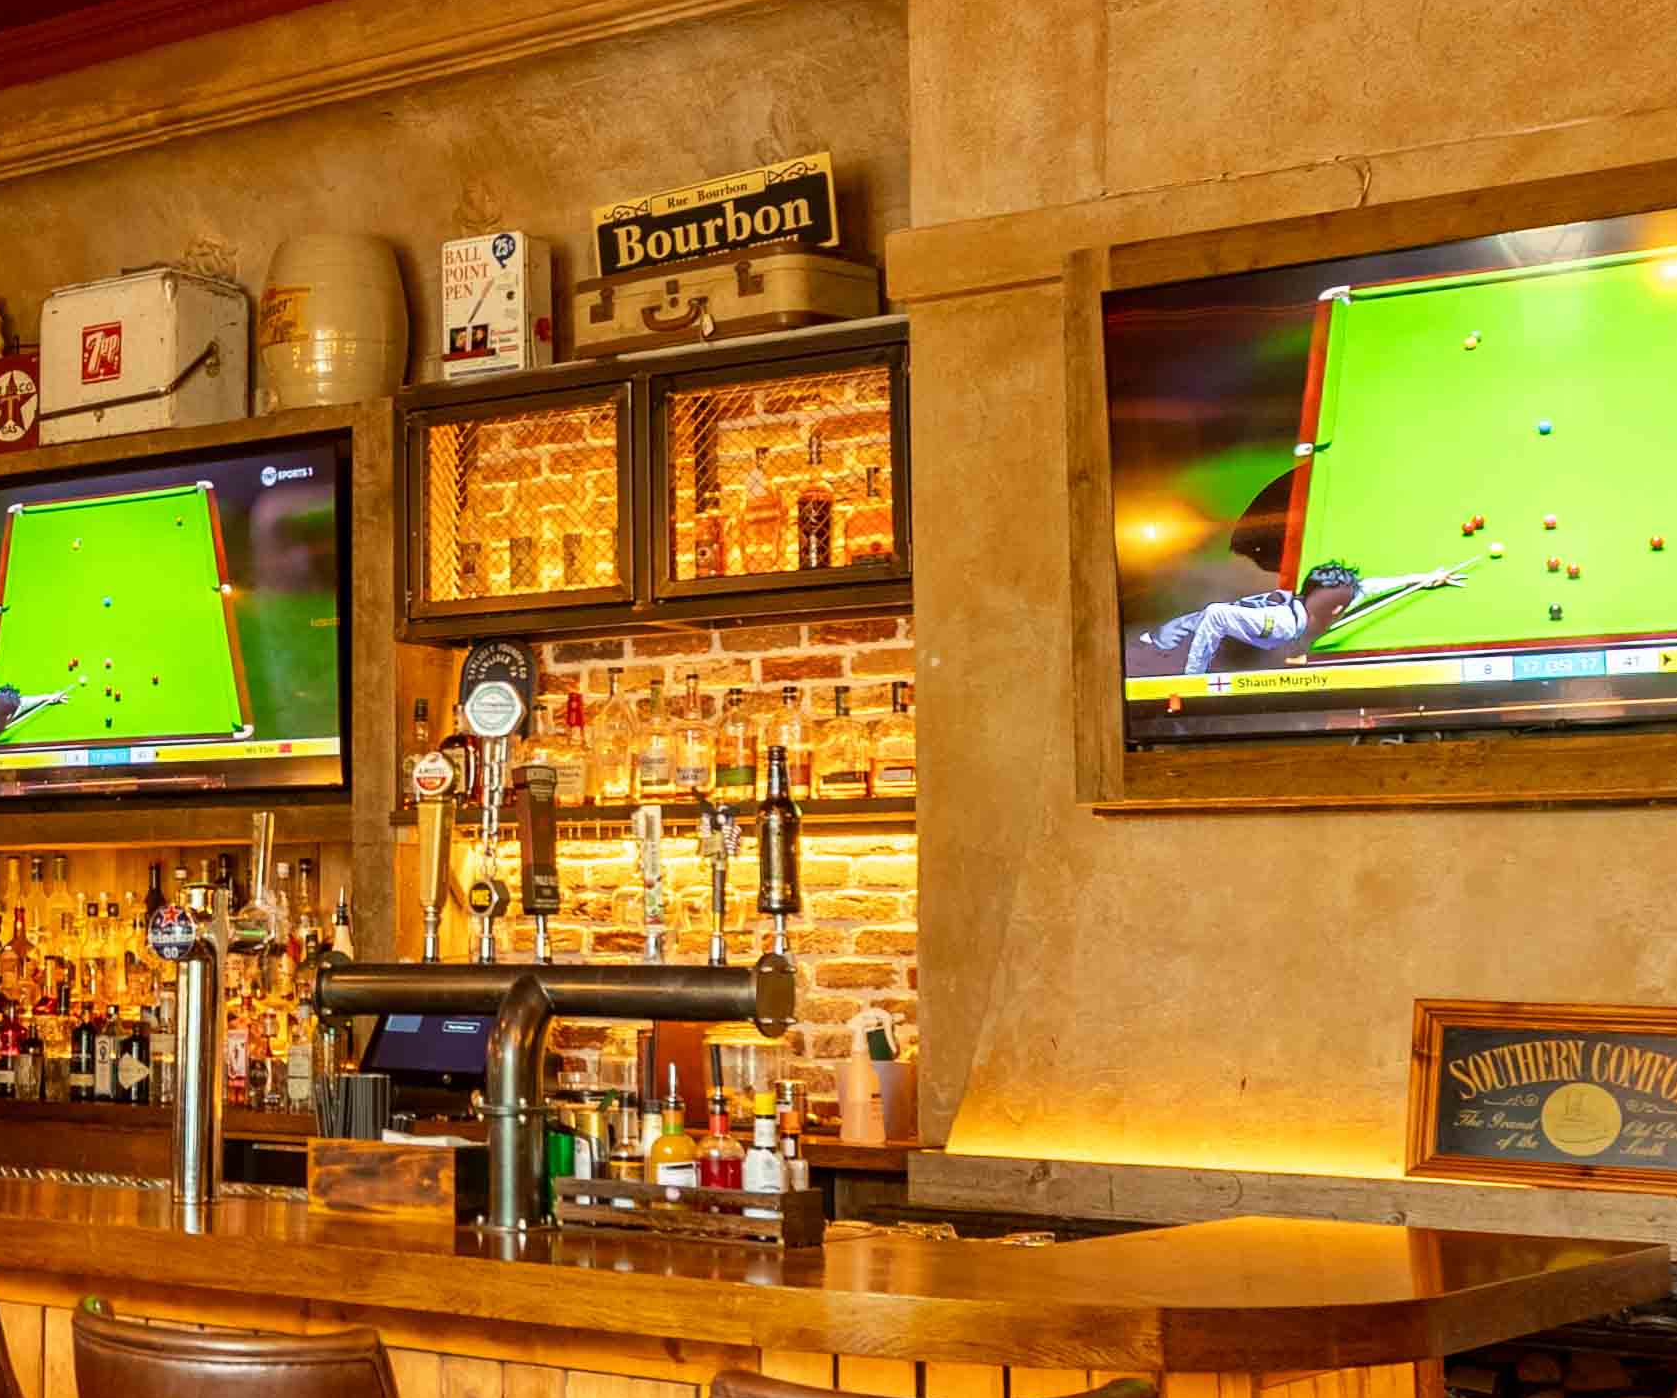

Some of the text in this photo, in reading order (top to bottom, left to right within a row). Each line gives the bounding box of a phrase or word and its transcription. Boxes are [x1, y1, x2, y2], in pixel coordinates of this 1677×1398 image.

[667, 182, 748, 208] Rue Bourbon
[613, 196, 814, 269] Bourbon
[445, 247, 482, 265] BALL
[445, 264, 489, 283] POINT
[445, 283, 474, 300] PEN
[1237, 674, 1328, 691] Shaun Murphy
[1449, 1040, 1586, 1100] SOUTHERN
[1453, 1110, 1485, 1128] The
[1496, 1131, 1511, 1150] of
